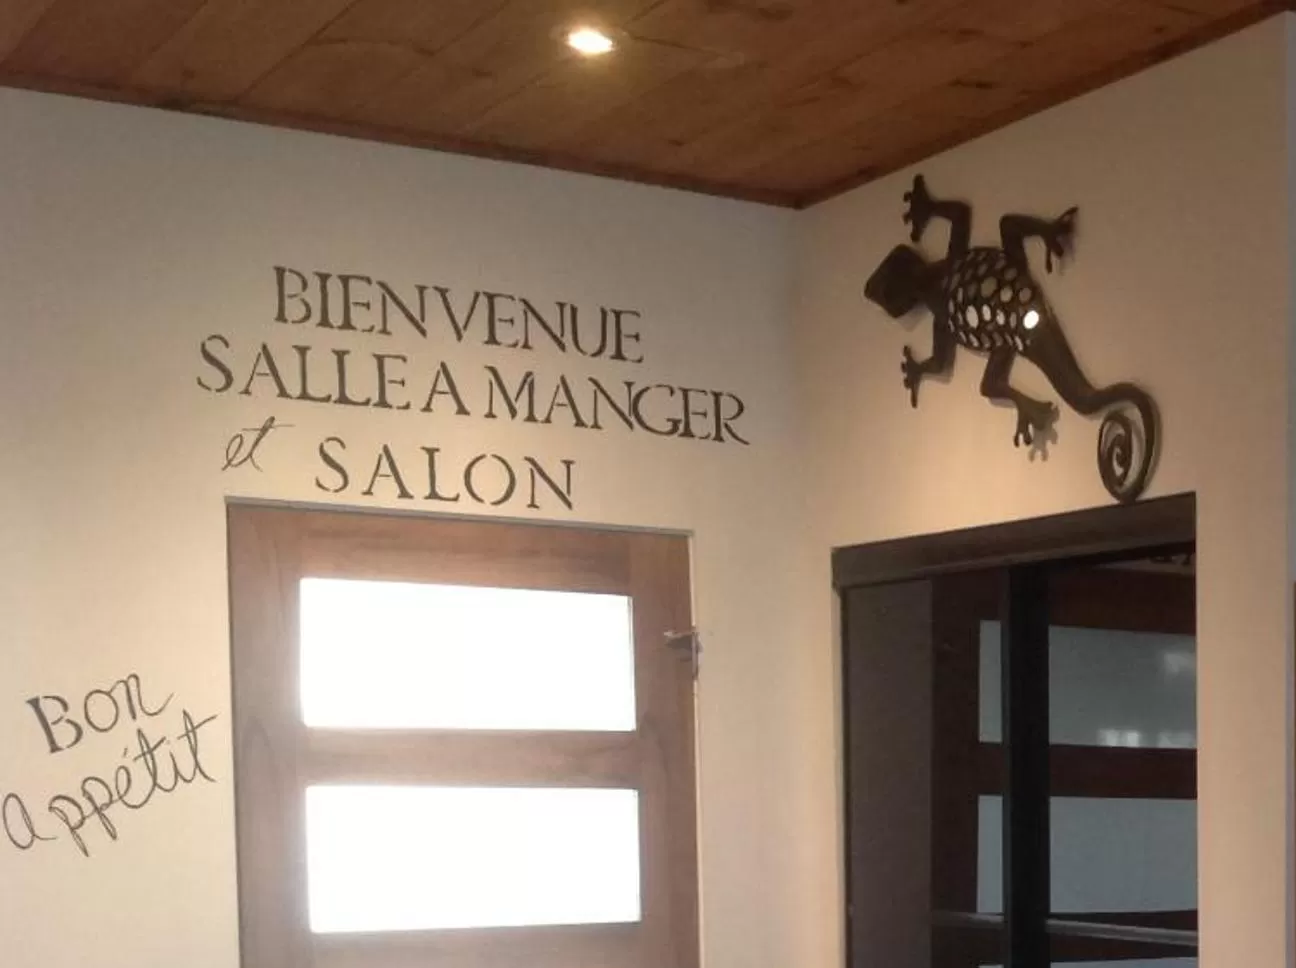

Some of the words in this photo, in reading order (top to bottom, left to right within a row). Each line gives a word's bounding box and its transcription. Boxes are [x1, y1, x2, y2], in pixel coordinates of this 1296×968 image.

[272, 265, 643, 363] BIENVENUE
[483, 365, 751, 446] MANGER
[221, 415, 294, 472] et
[315, 436, 575, 511] SALON
[25, 673, 175, 755] Bon
